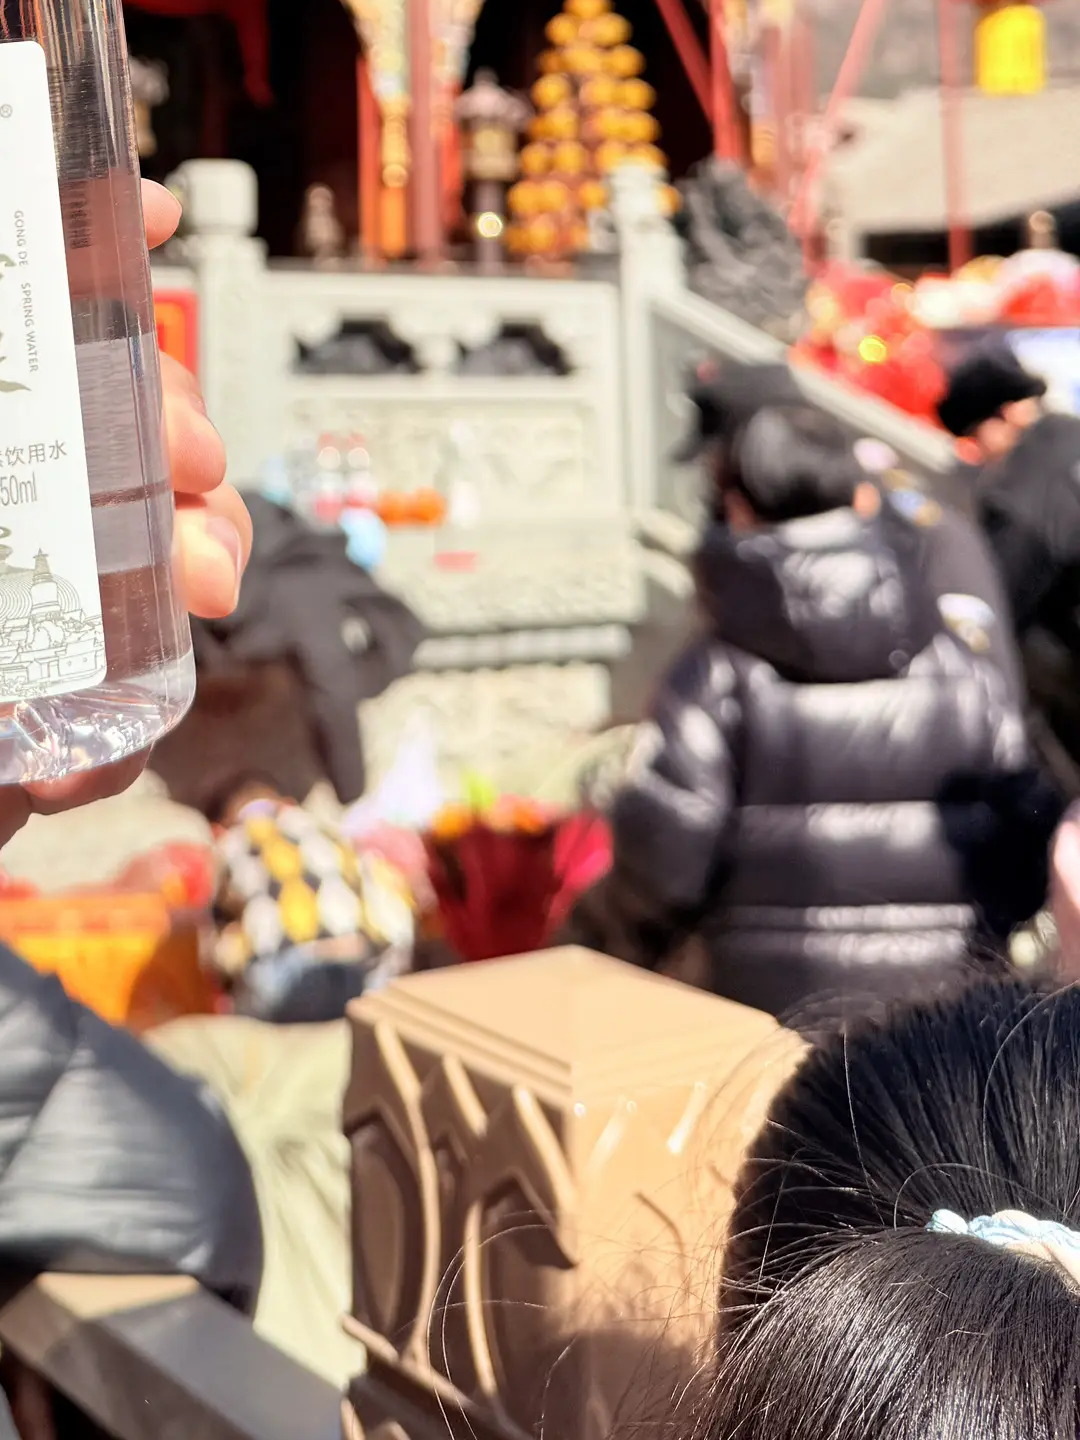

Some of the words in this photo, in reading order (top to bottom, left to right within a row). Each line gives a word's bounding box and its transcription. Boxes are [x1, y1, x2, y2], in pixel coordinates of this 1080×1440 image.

[14, 210, 26, 248] GONG
[17, 251, 29, 267] DE
[21, 283, 35, 328] SPRING
[26, 331, 39, 373] WATER
